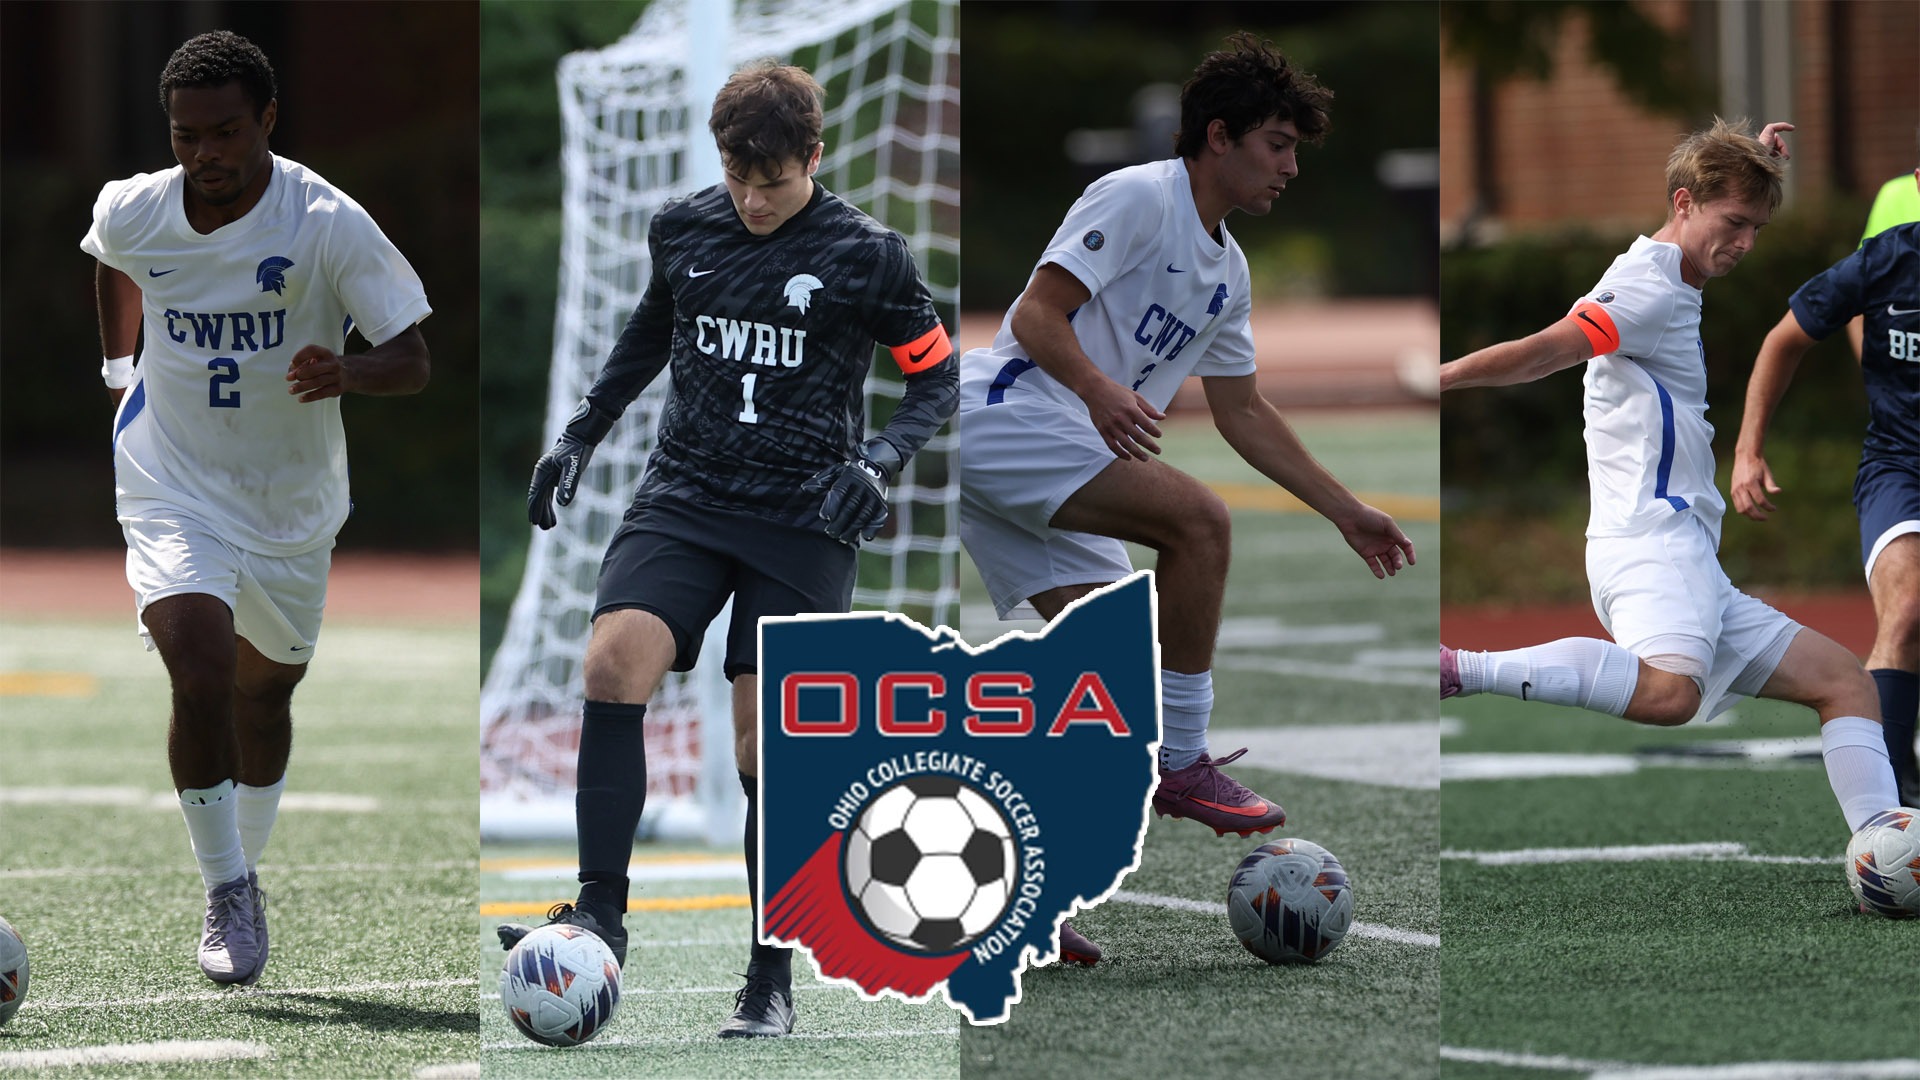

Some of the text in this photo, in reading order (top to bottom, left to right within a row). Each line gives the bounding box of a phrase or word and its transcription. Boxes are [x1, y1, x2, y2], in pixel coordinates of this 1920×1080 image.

[164, 308, 286, 352] CWRU
[695, 314, 807, 368] CWRU
[1888, 328, 1920, 363] BE
[207, 357, 241, 408] 2
[738, 372, 759, 424] 1
